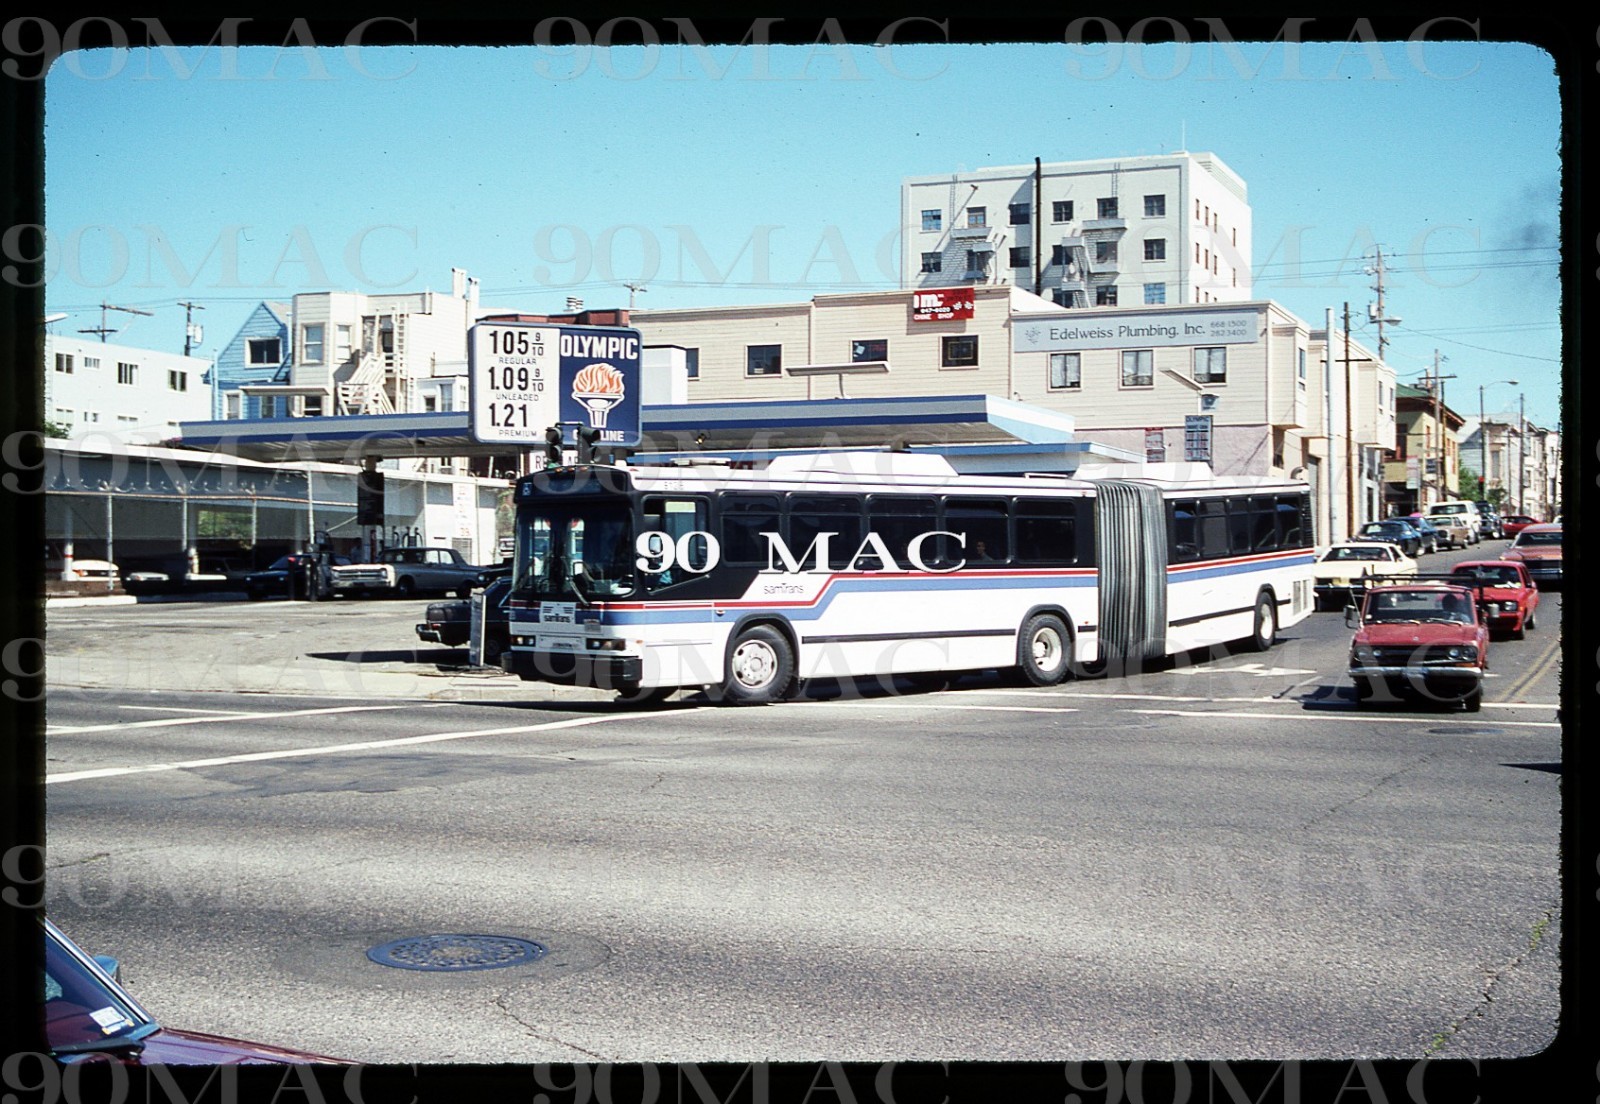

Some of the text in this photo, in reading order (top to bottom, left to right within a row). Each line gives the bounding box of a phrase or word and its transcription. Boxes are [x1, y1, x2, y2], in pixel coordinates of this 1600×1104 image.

[1050, 328, 1113, 340] Edelweiss
[1184, 322, 1206, 336] Inc.
[560, 335, 638, 360] OLYMPIC
[499, 356, 537, 365] REGULAR
[488, 366, 529, 391] 1.09
[496, 393, 539, 402] UNLEADED
[488, 403, 528, 427] 1.21
[499, 429, 537, 438] PREMIUM
[573, 429, 625, 442] GLINE
